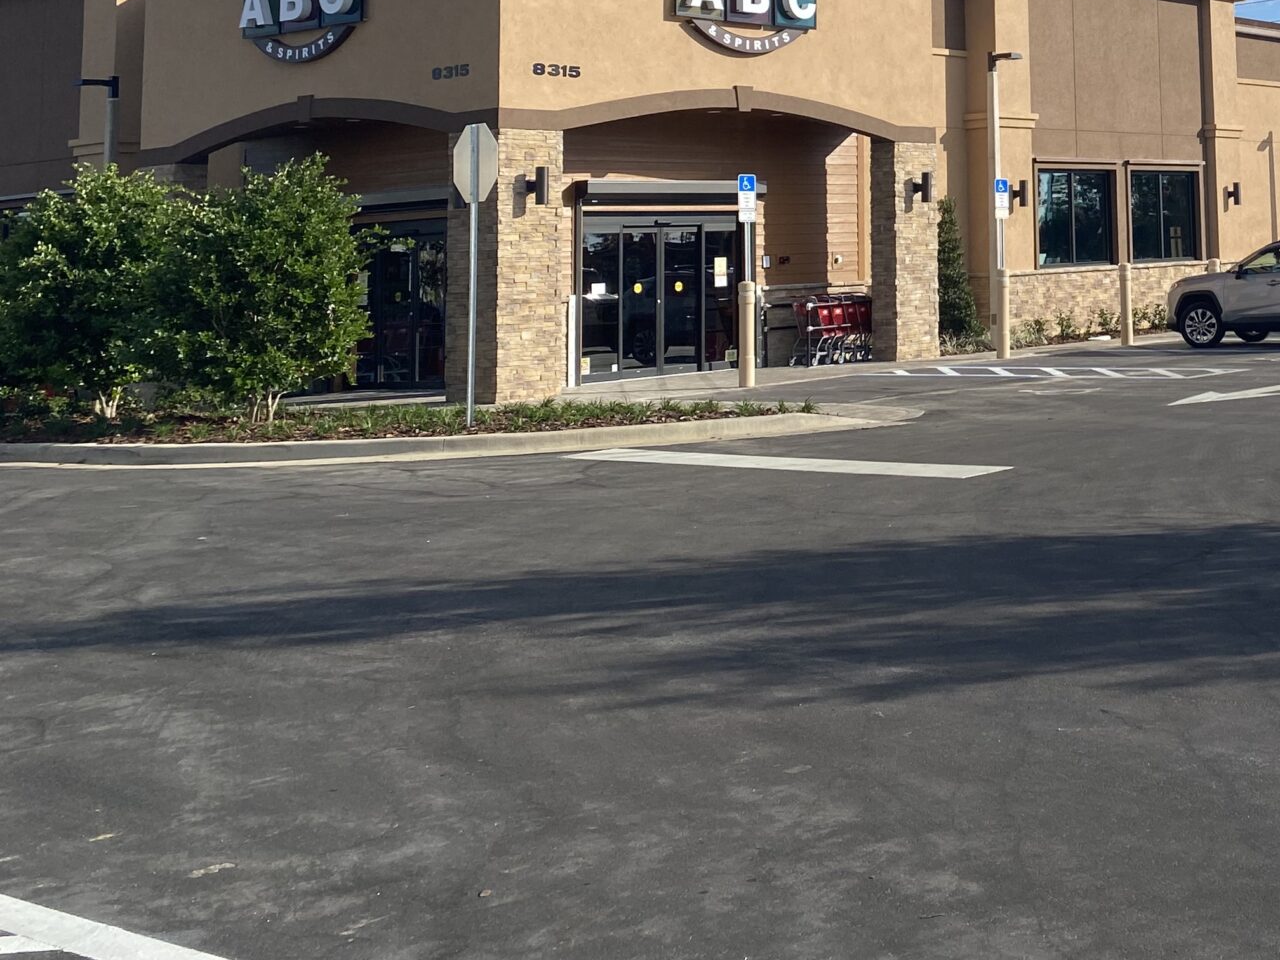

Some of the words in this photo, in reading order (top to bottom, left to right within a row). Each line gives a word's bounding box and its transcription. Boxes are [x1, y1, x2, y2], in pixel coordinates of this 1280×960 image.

[276, 32, 335, 60] SPIRITS
[723, 32, 791, 51] SPIRITS
[431, 63, 470, 81] 8315
[532, 62, 581, 78] 8315
